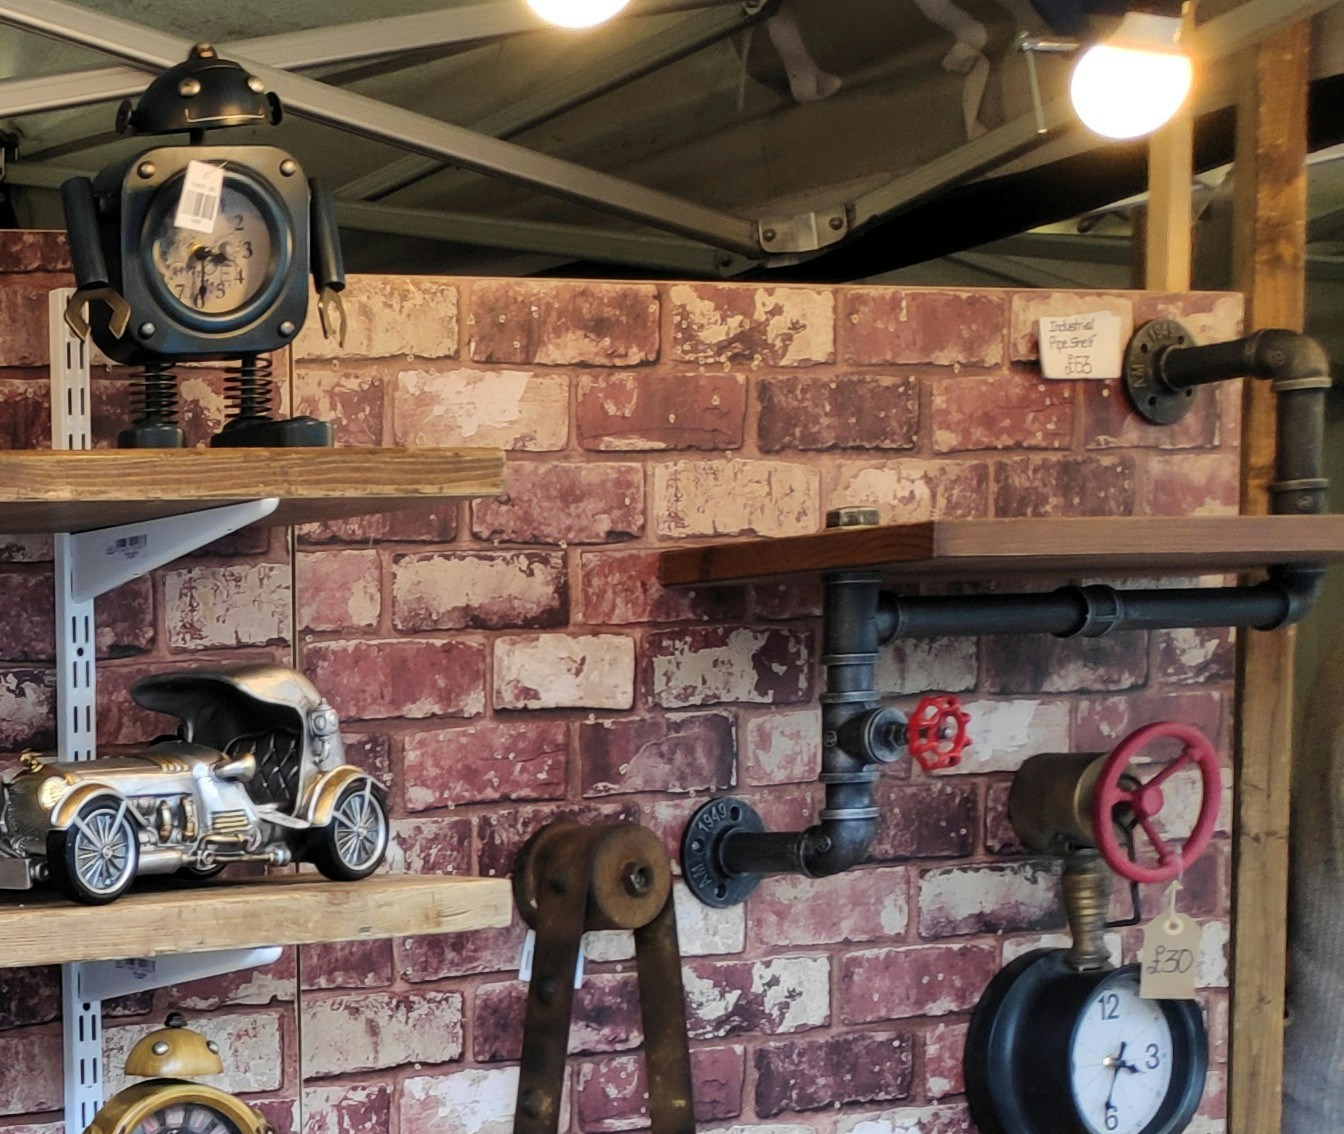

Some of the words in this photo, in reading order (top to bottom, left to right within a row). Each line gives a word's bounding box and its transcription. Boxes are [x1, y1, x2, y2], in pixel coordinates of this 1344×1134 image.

[233, 214, 244, 231] 2
[698, 802, 728, 833] 1949
[1145, 944, 1194, 975] £30
[1098, 993, 1120, 1021] 12
[1144, 1043, 1160, 1070] 3
[1105, 1105, 1119, 1131] 6
